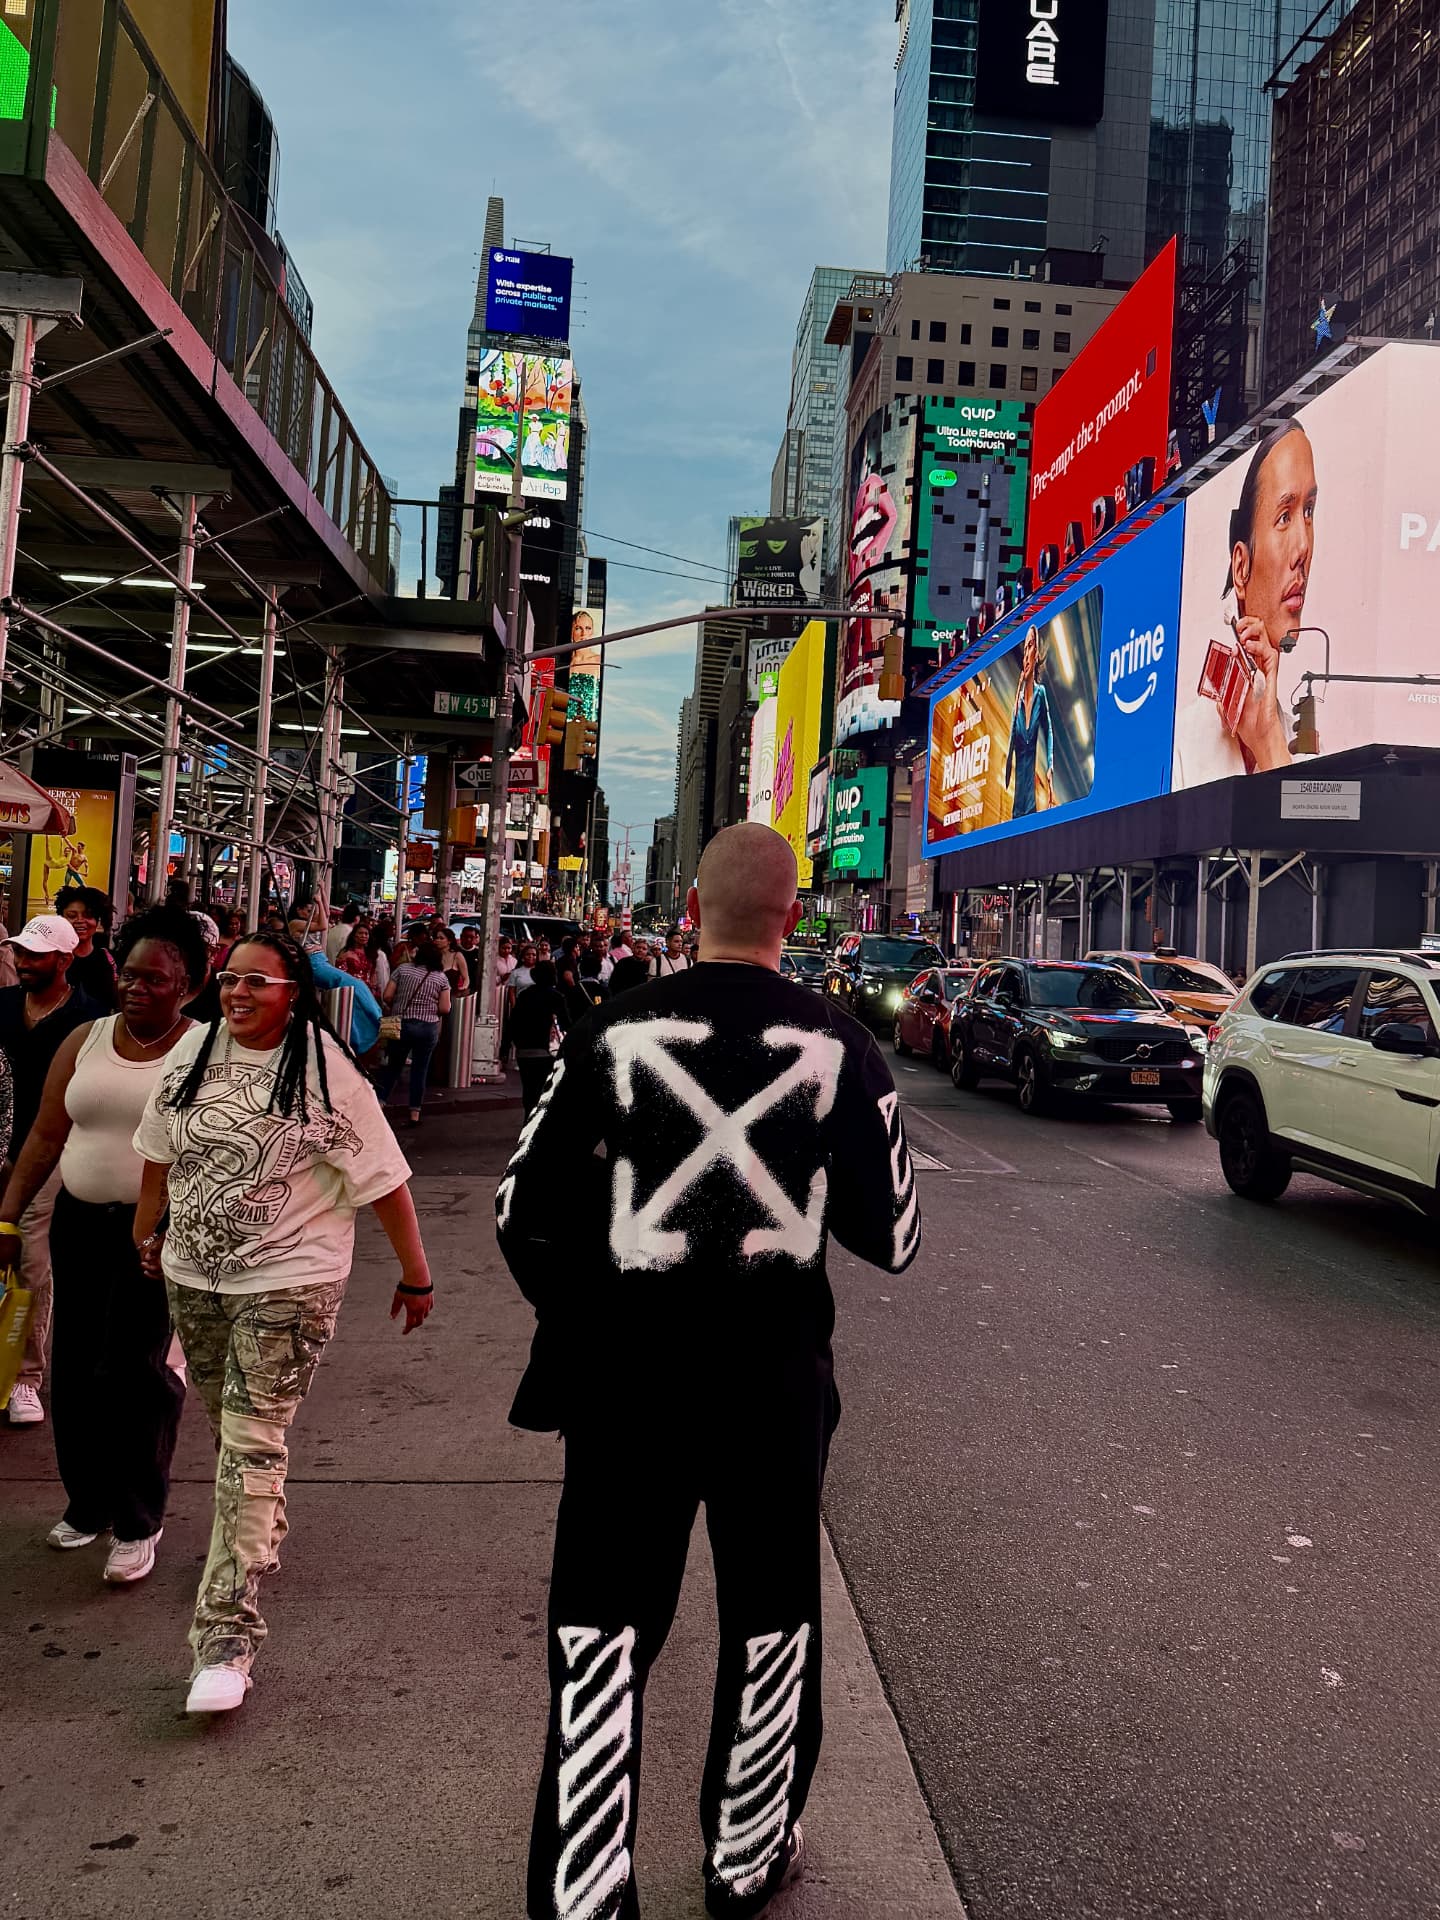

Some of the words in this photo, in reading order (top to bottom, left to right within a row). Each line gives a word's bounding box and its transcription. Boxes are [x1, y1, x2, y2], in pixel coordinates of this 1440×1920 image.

[495, 278, 515, 288] With
[515, 283, 552, 294] expertise
[494, 296, 523, 306] private
[523, 300, 558, 311] markets.
[495, 288, 521, 297] across
[521, 292, 546, 301] public
[547, 296, 564, 304] and
[960, 406, 996, 422] quip
[936, 425, 960, 436] Ultra
[960, 427, 978, 437] Lite
[1031, 438, 1076, 501] Pre-empt
[1076, 420, 1094, 454] the
[1094, 367, 1143, 444] prompt.
[947, 437, 1006, 450] Toothbrush
[756, 640, 790, 660] LITTLE
[1108, 623, 1165, 695] prime
[451, 695, 460, 712] W
[463, 697, 479, 714] 45
[87, 753, 120, 761] LinkNYC
[941, 734, 990, 792] RUNNER
[467, 769, 491, 781] ONE
[1313, 783, 1342, 793] BROADWAY
[836, 786, 861, 817] quip
[224, 1195, 270, 1224] BRIGADE
